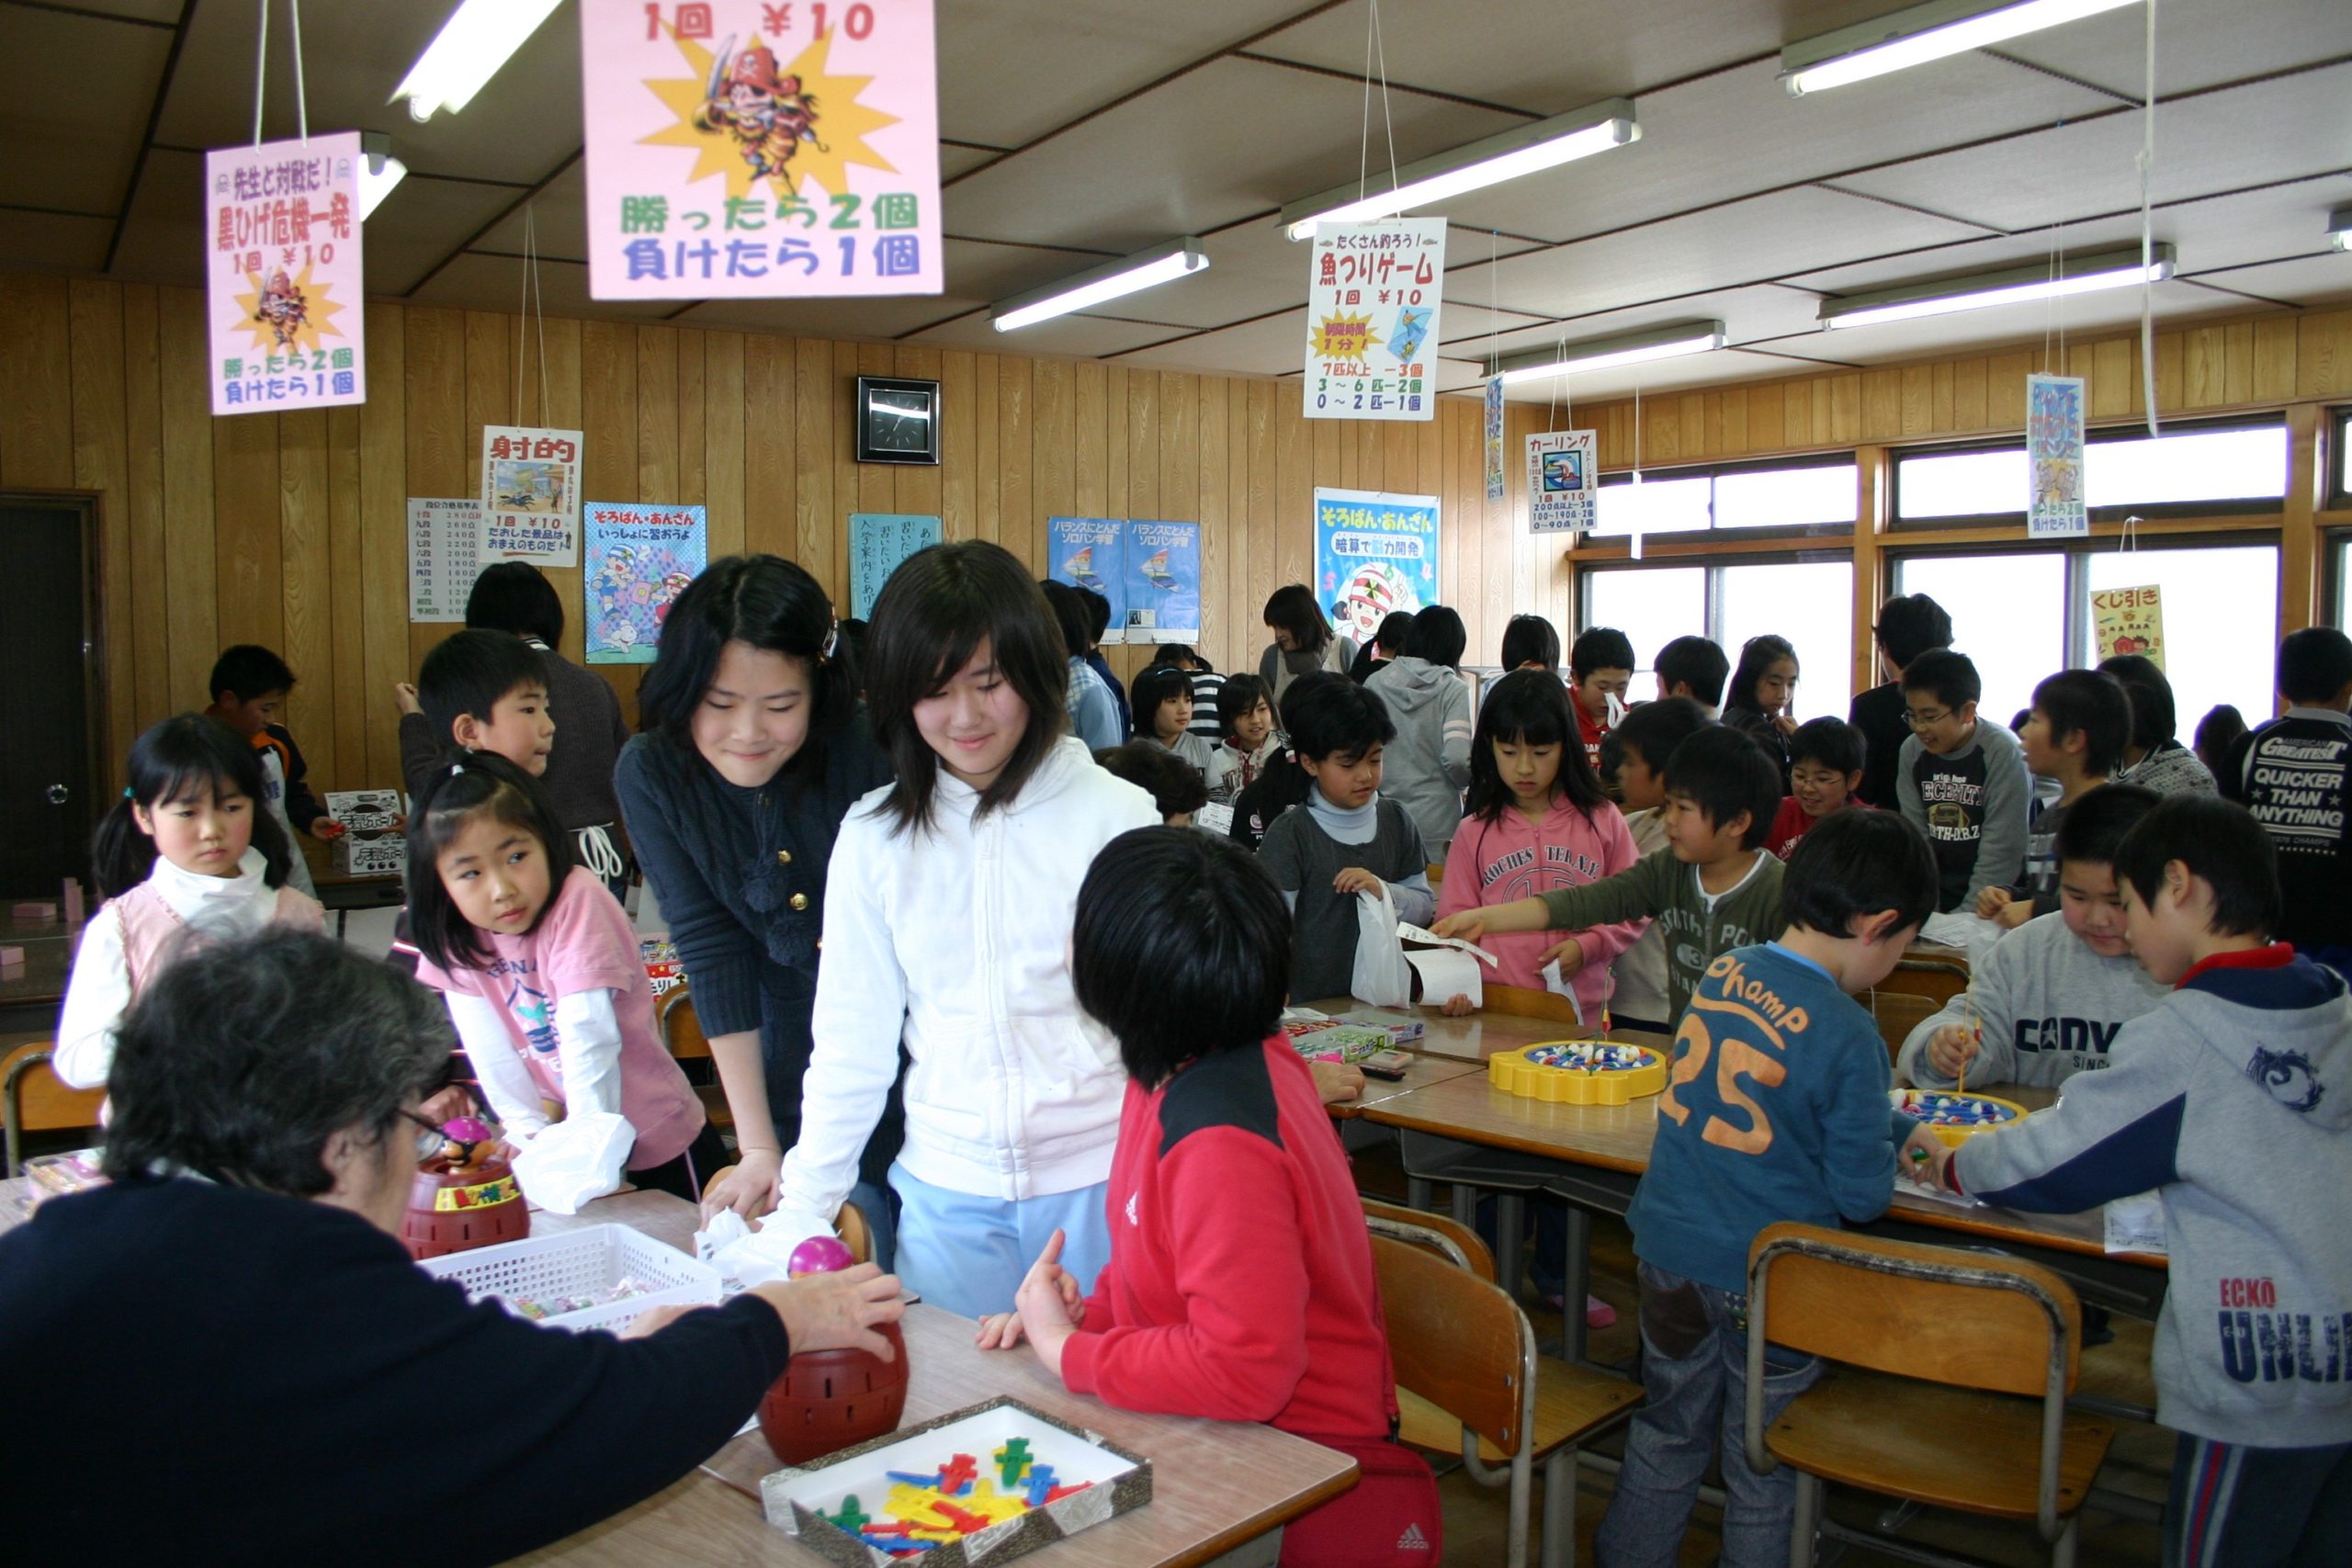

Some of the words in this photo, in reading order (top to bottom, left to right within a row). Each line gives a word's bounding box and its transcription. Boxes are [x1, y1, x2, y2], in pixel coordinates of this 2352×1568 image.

[645, 3, 714, 40] 1回
[763, 3, 874, 40] ¥10
[620, 193, 919, 233] 勝ったら2個
[1337, 233, 1420, 249] たくさん釣ろう！
[234, 252, 263, 273] 1回
[282, 243, 334, 266] ¥10
[622, 234, 920, 281] 負けたら1個
[1319, 252, 1433, 286] 魚つりゲーム
[1335, 289, 1361, 305] 1回
[1378, 289, 1422, 305] ¥10
[223, 347, 354, 379] 勝ったら2個
[224, 370, 355, 405] 負けたら1個
[490, 435, 575, 463] 射的
[1531, 434, 1590, 451] カーリング
[496, 515, 515, 526] 1回
[528, 517, 560, 529] ¥10
[594, 510, 695, 525] そろばん・あんざん
[1321, 506, 1434, 533] そろばん・あんざん
[2032, 517, 2085, 532] 負けたら1個
[488, 527, 564, 539] たおした景品は
[598, 528, 690, 540] いっしょに習おうよ
[1054, 521, 1120, 536] バランスにとんだ
[1132, 524, 1194, 536] バランスにとんだ
[1062, 533, 1114, 545] ソロバン学習
[1139, 536, 1190, 547] ソロバン学習
[2093, 589, 2158, 610] くじ引き
[2254, 768, 2343, 789] QUICKER
[2270, 788, 2323, 807] THAN
[2249, 804, 2344, 827] ANYTHING
[1720, 923, 1757, 948] PO
[1690, 949, 1702, 966] 3
[1658, 1012, 1788, 1156] 25
